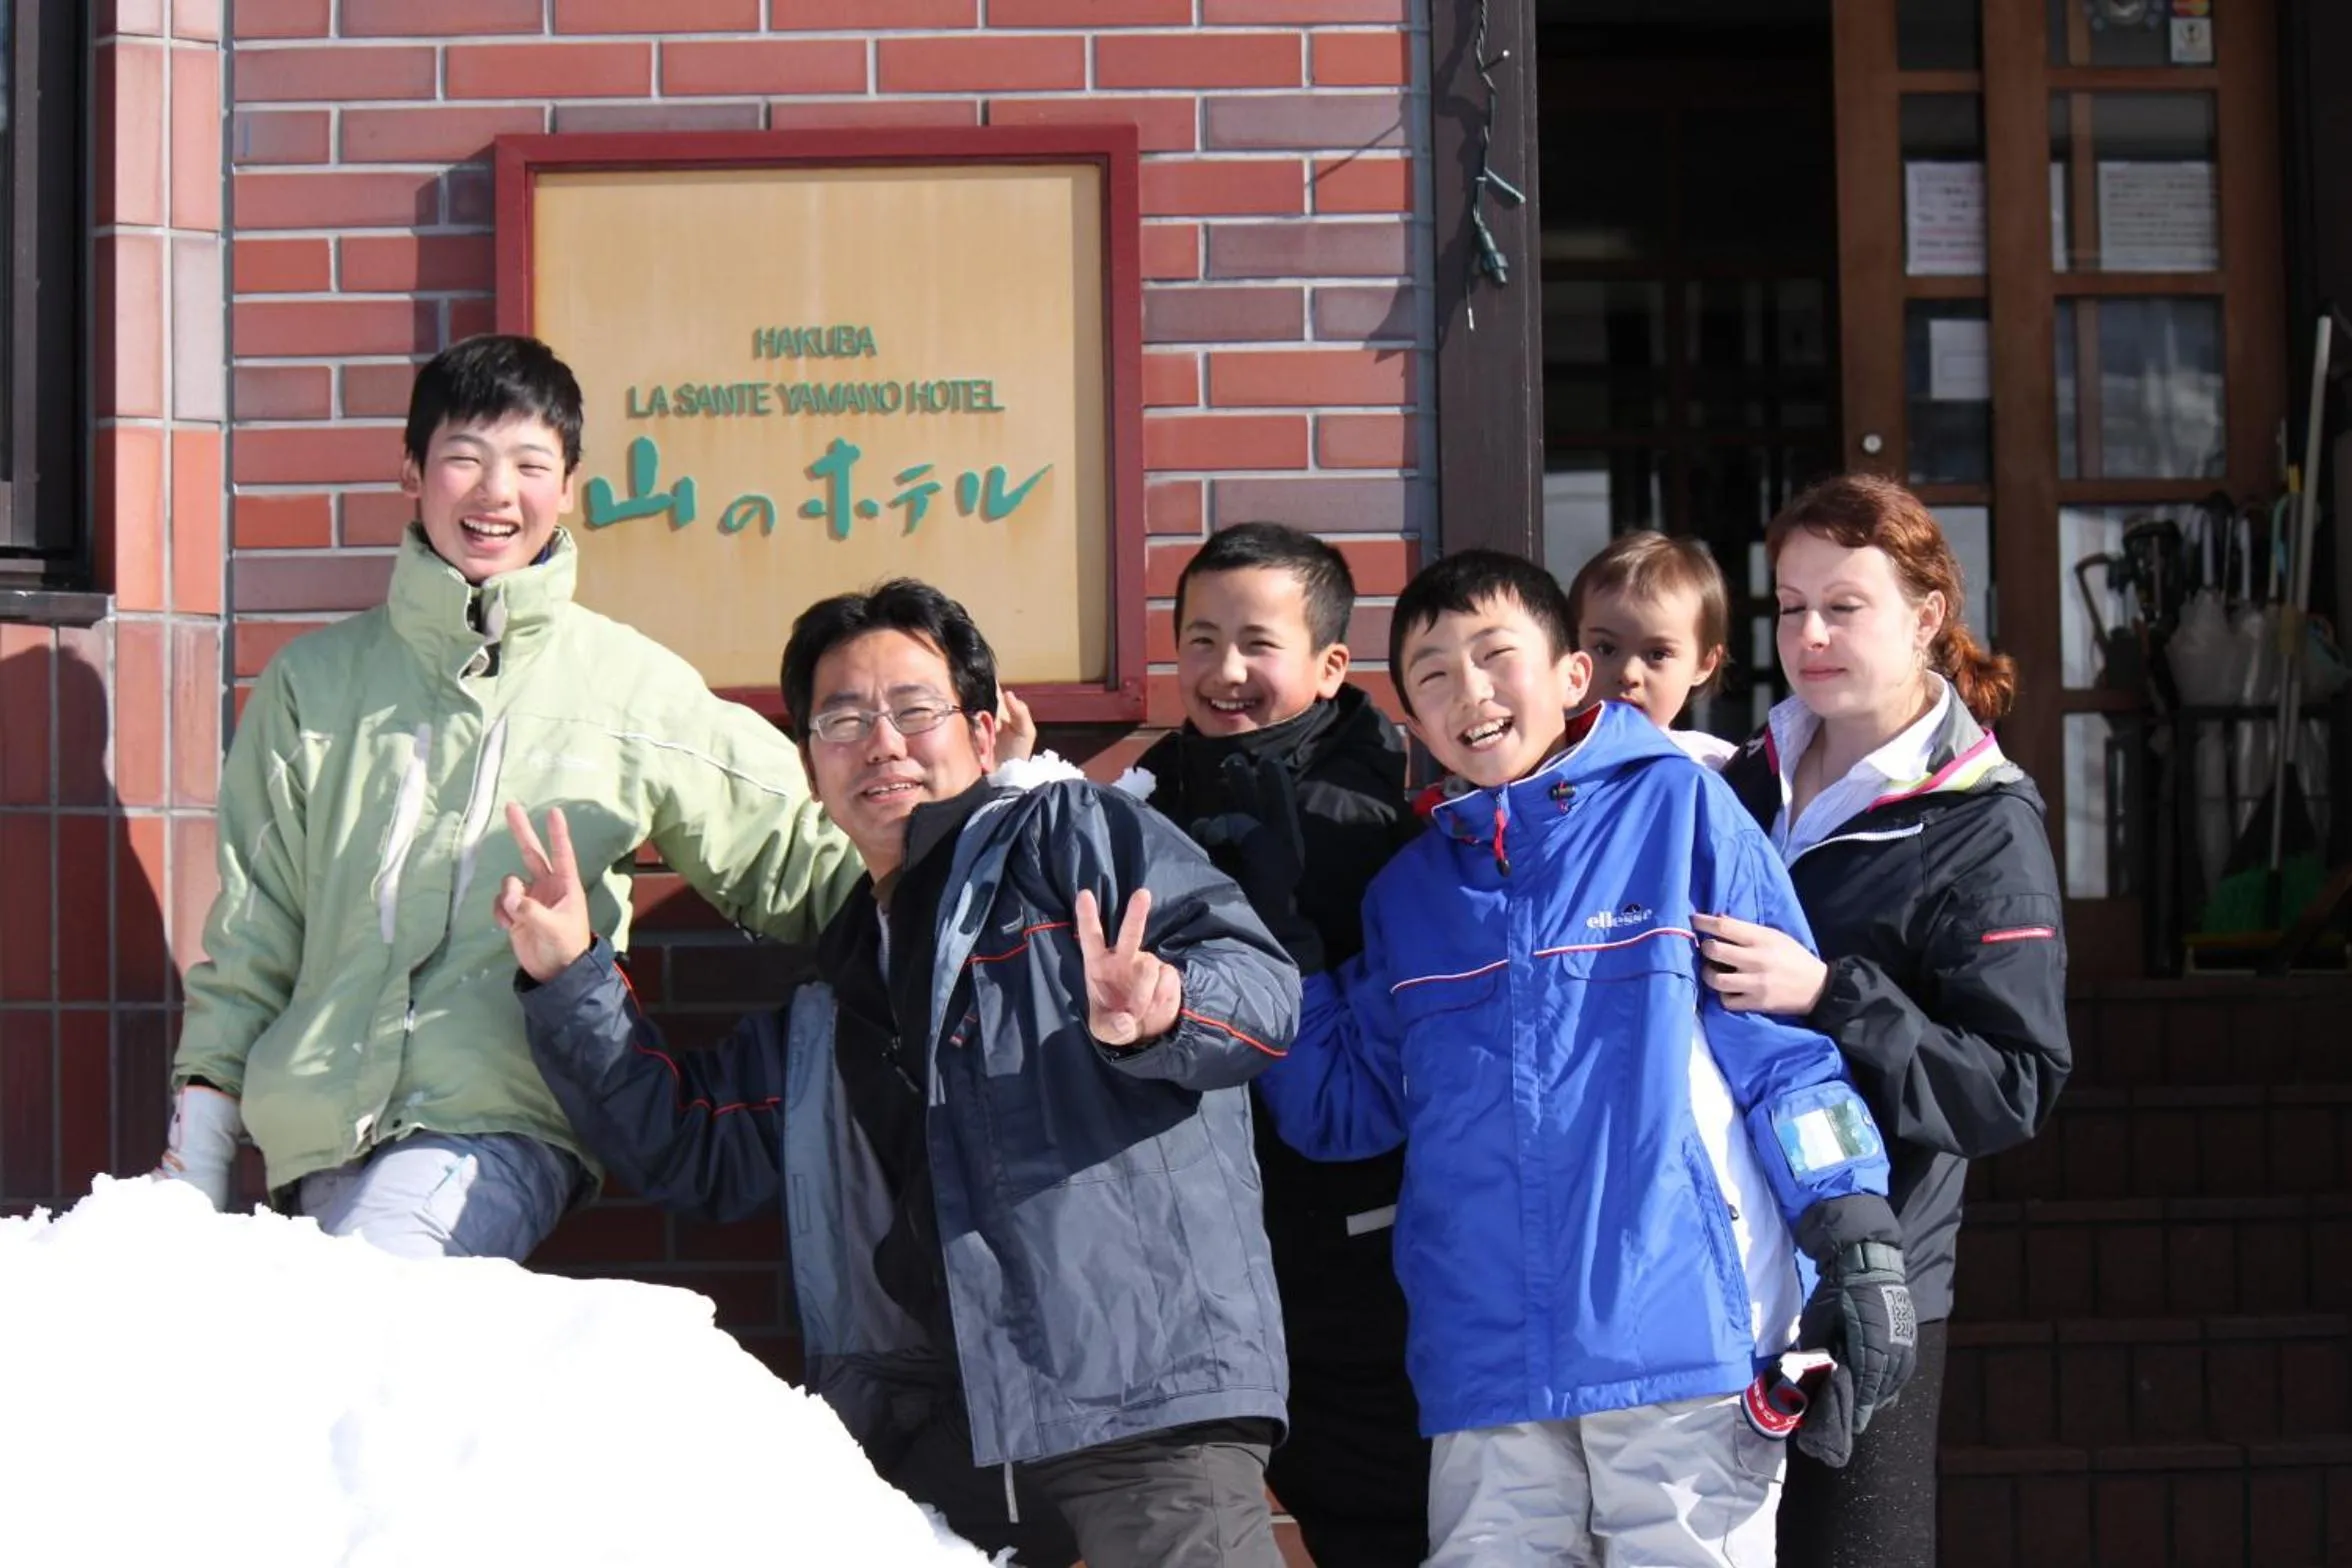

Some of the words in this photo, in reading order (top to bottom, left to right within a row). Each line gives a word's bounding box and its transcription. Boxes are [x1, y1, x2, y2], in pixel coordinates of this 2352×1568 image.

[752, 325, 877, 360] HAKUBA
[626, 384, 670, 419] LA
[672, 382, 772, 418] SANTE
[774, 380, 901, 416] YAMANO
[905, 379, 1005, 416] HOTEL
[582, 436, 1054, 540] 山のホテル
[1586, 908, 1653, 929] ellesse
